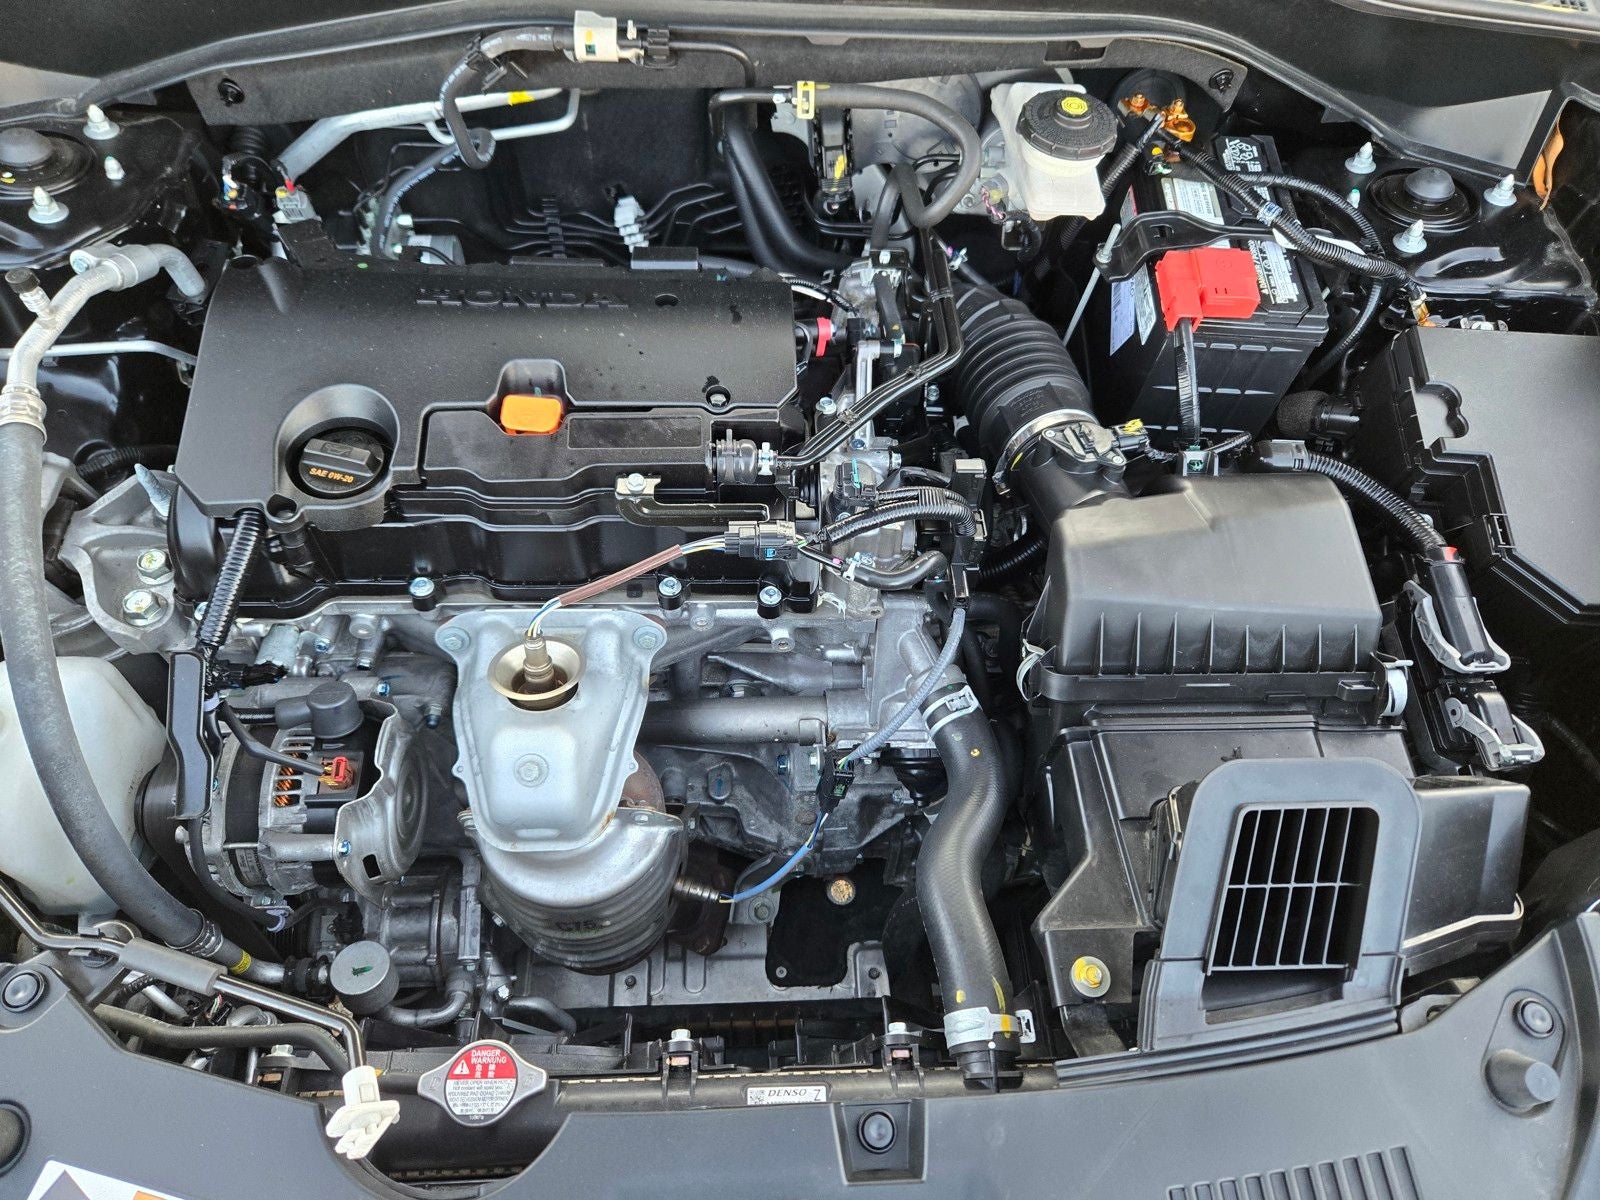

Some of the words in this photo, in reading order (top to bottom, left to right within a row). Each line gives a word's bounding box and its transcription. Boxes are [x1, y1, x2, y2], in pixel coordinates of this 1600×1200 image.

[416, 287, 629, 308] HONDA
[309, 467, 328, 478] SAE
[328, 472, 354, 483] 0W-20
[471, 1049, 501, 1057] DANGER
[471, 1056, 507, 1064] WARNUNG
[768, 1089, 807, 1097] DENSO
